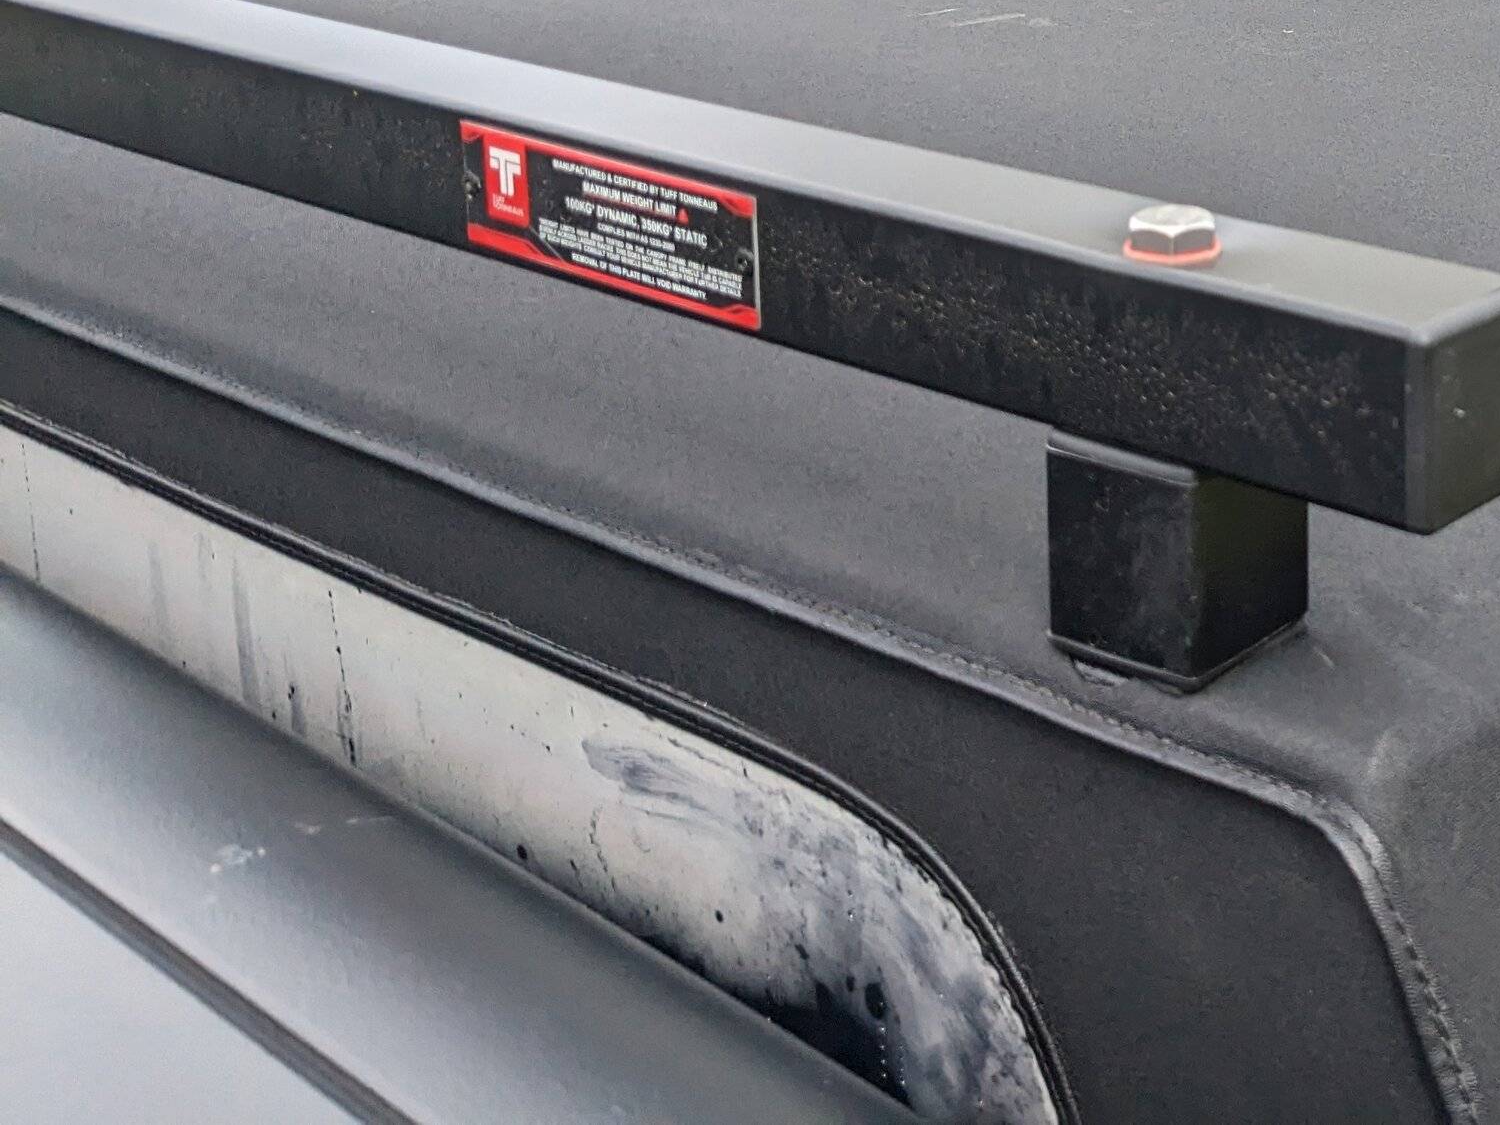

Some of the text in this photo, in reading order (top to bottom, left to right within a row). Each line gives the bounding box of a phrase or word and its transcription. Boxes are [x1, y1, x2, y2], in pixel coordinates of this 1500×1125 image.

[582, 180, 676, 216] MAXIMUM WEIGHT LIMIT
[613, 174, 648, 193] CERTIFIED
[649, 183, 658, 195] BY
[661, 186, 677, 201] TUFF
[678, 191, 717, 211] TONNEAUS
[673, 225, 707, 247] STATIC
